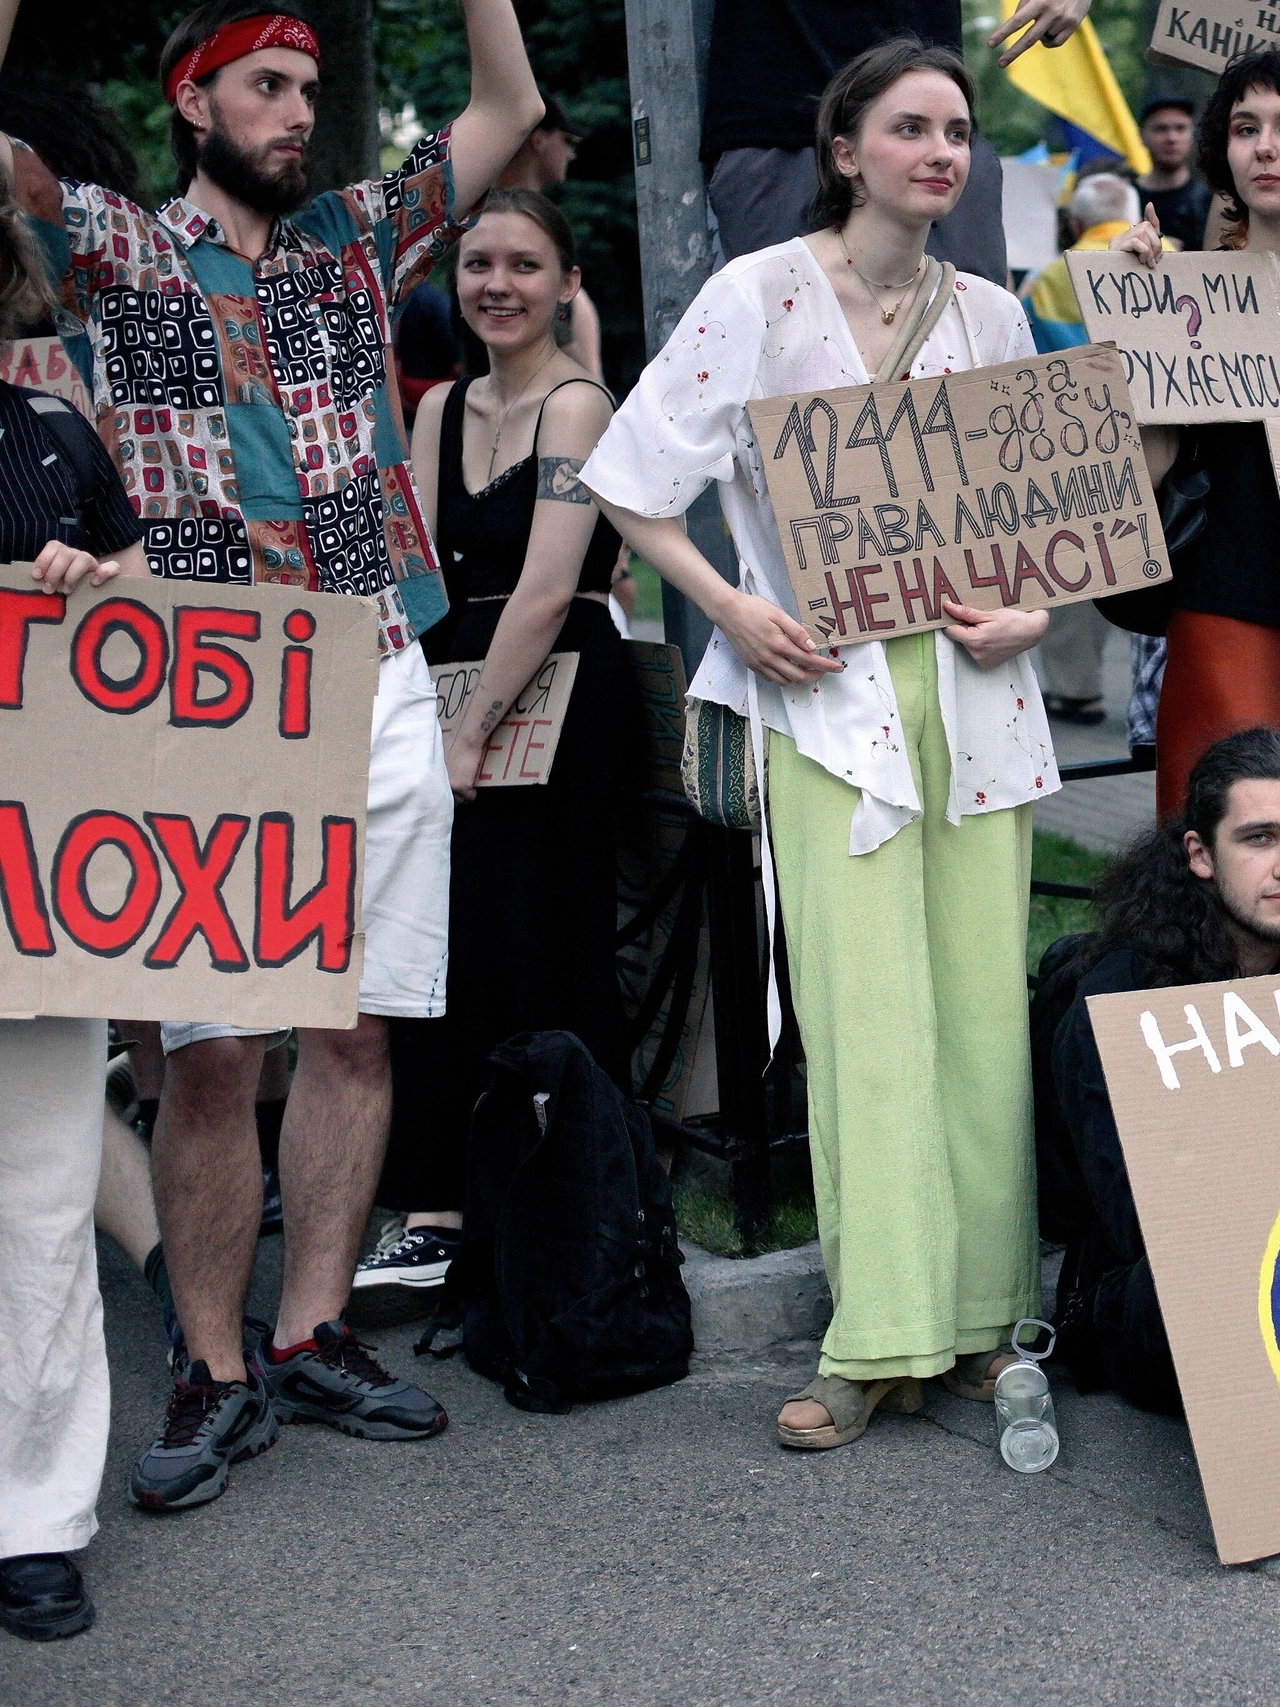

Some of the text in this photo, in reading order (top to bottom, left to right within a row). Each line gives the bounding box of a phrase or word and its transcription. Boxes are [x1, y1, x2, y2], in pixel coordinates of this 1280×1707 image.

[1166, 7, 1277, 59] КАНІК
[1086, 269, 1177, 319] КУДИ
[1202, 272, 1260, 315] МИ
[789, 456, 1142, 570] ПРАВА ЛЮДИНИ
[893, 555, 963, 625] НА
